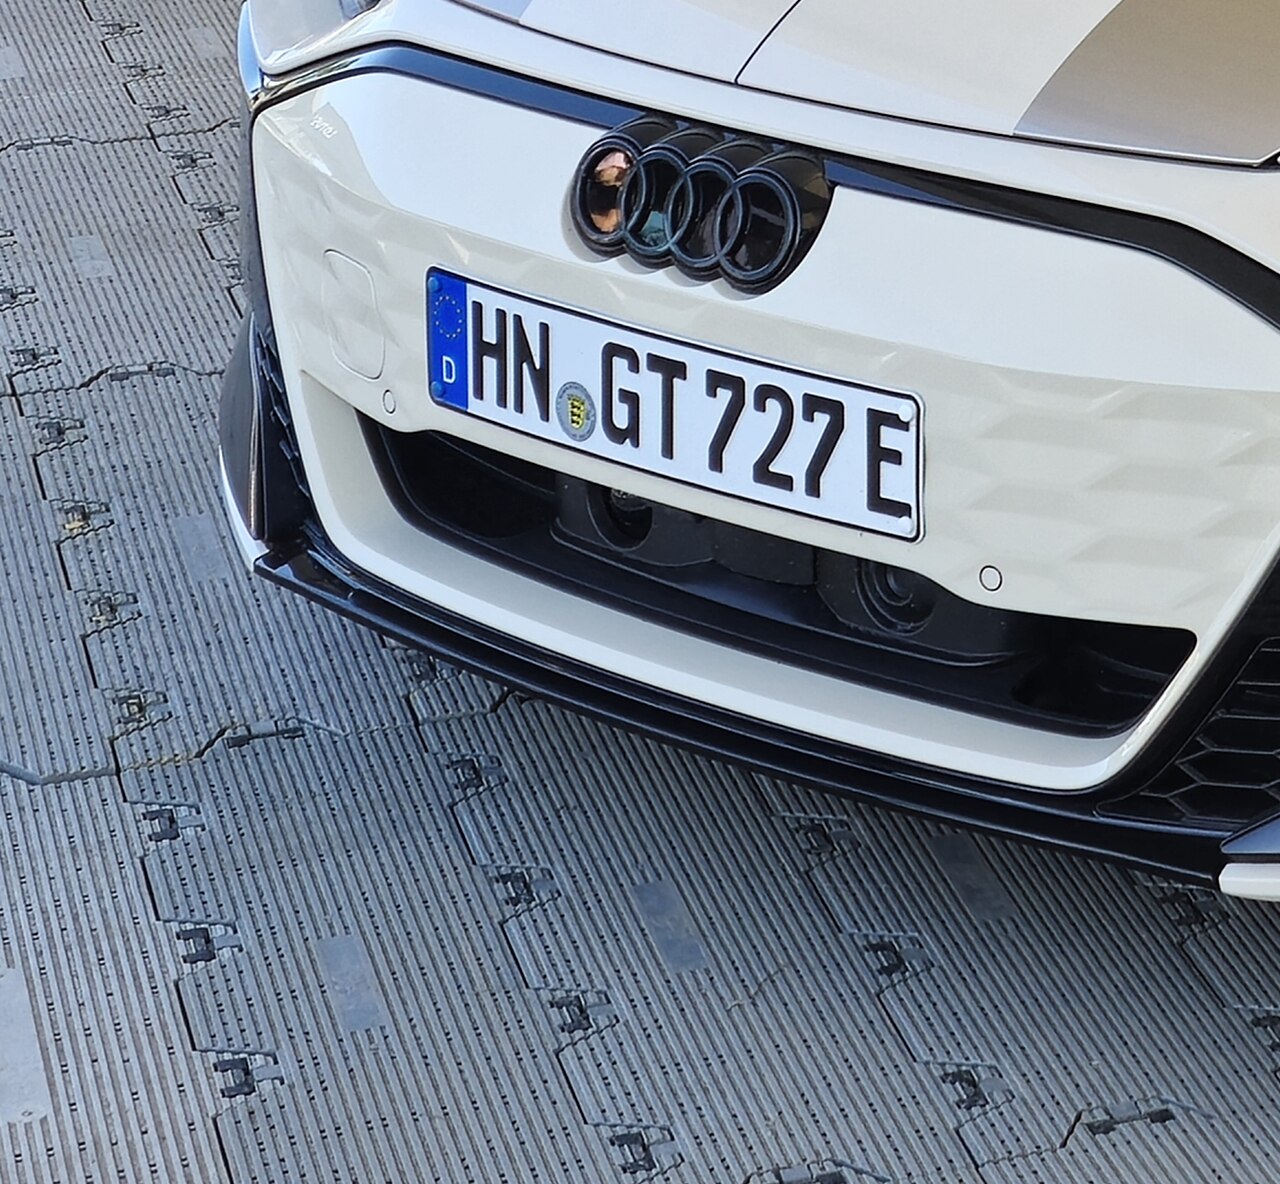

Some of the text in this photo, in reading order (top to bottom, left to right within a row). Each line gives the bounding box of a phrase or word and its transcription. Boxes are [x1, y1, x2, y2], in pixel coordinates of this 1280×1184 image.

[442, 355, 456, 384] D
[471, 300, 550, 423] HN
[601, 341, 687, 460] GT
